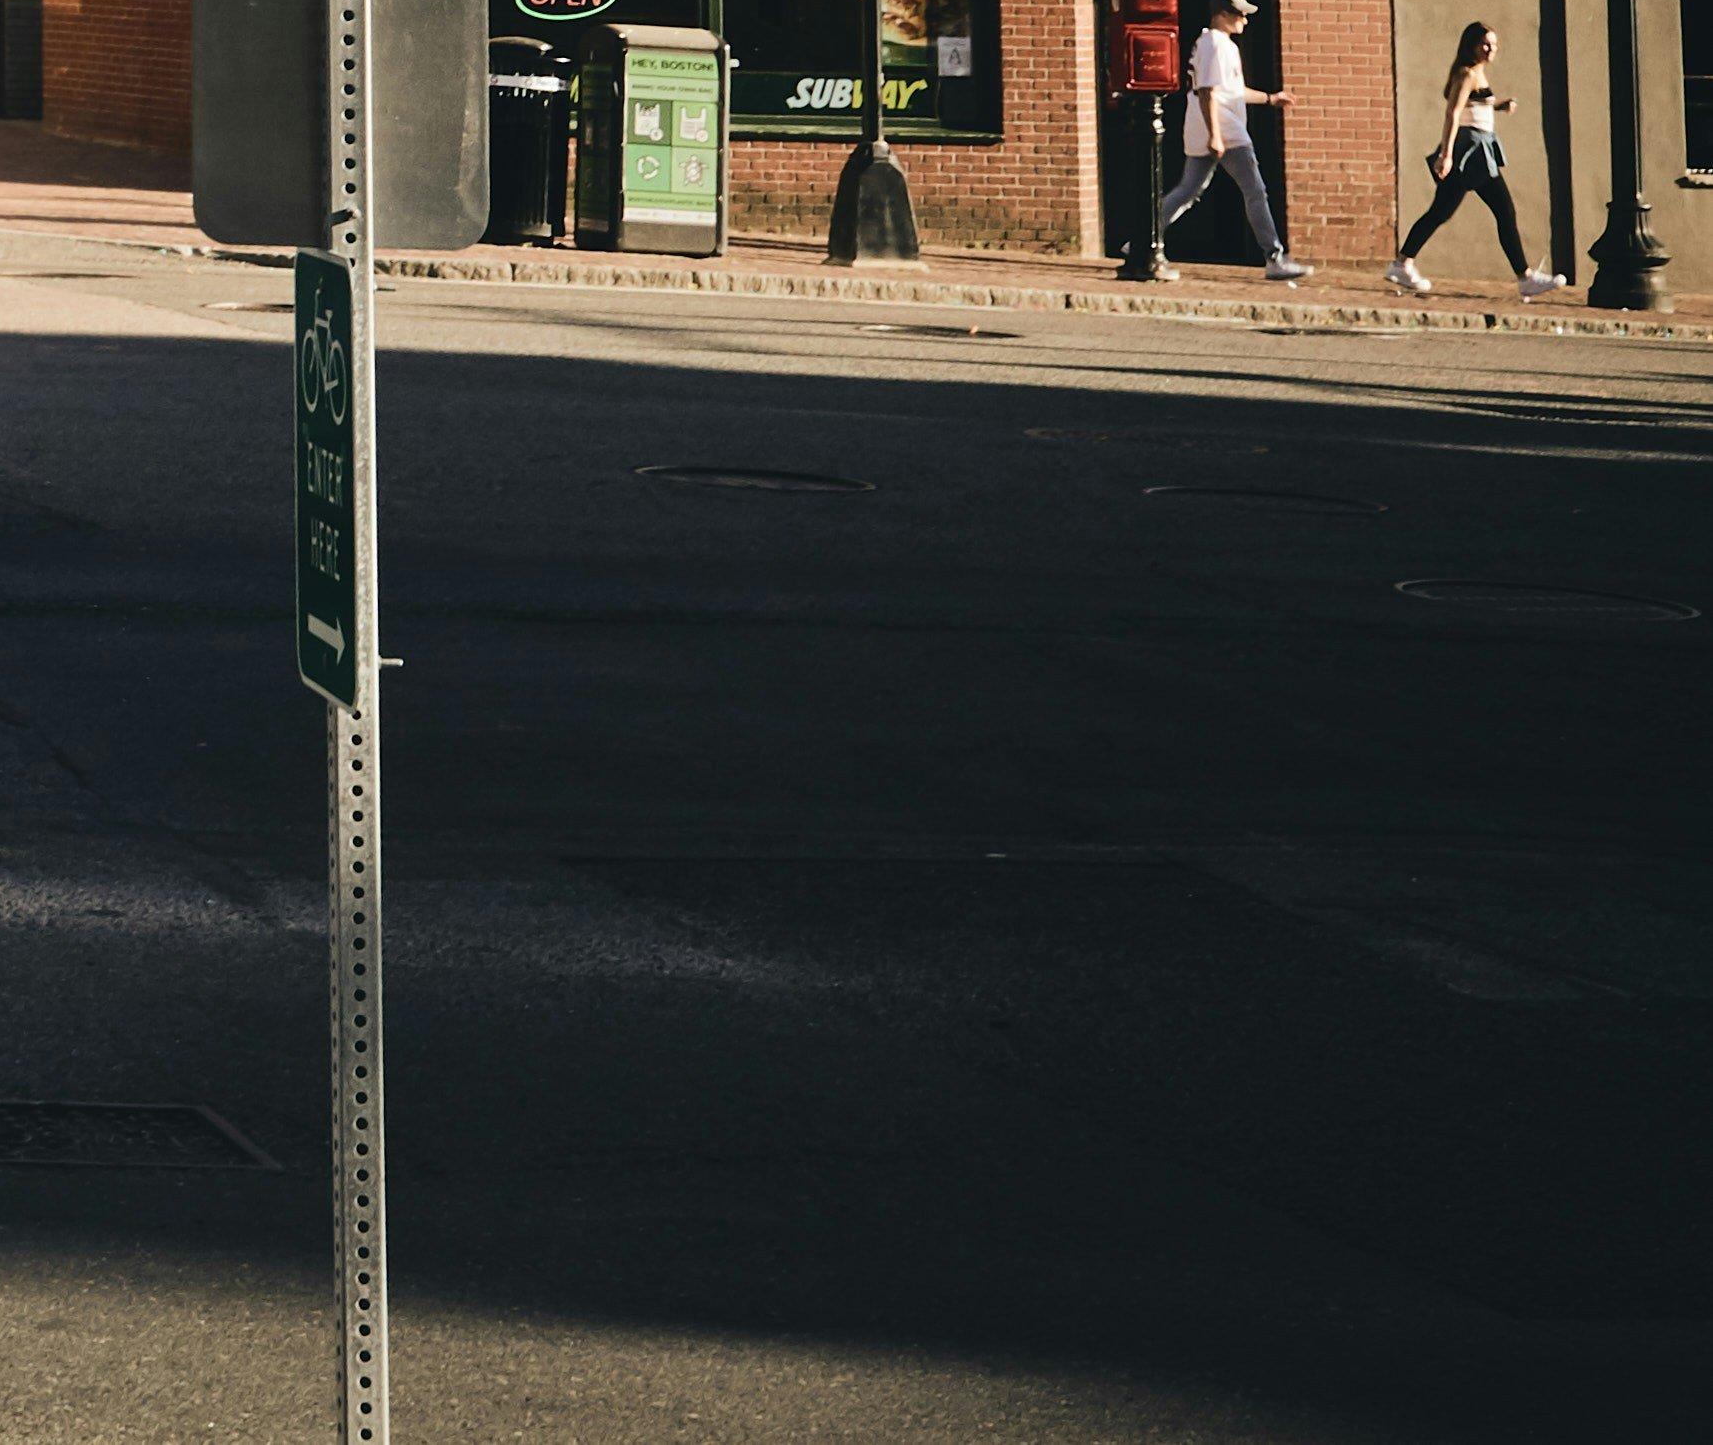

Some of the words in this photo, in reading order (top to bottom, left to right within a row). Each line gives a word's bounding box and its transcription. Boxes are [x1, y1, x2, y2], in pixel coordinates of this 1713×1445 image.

[632, 58, 657, 69] HEY,
[661, 59, 714, 71] BOSTON!
[307, 441, 343, 508] ENTER
[310, 516, 341, 582] HERE
